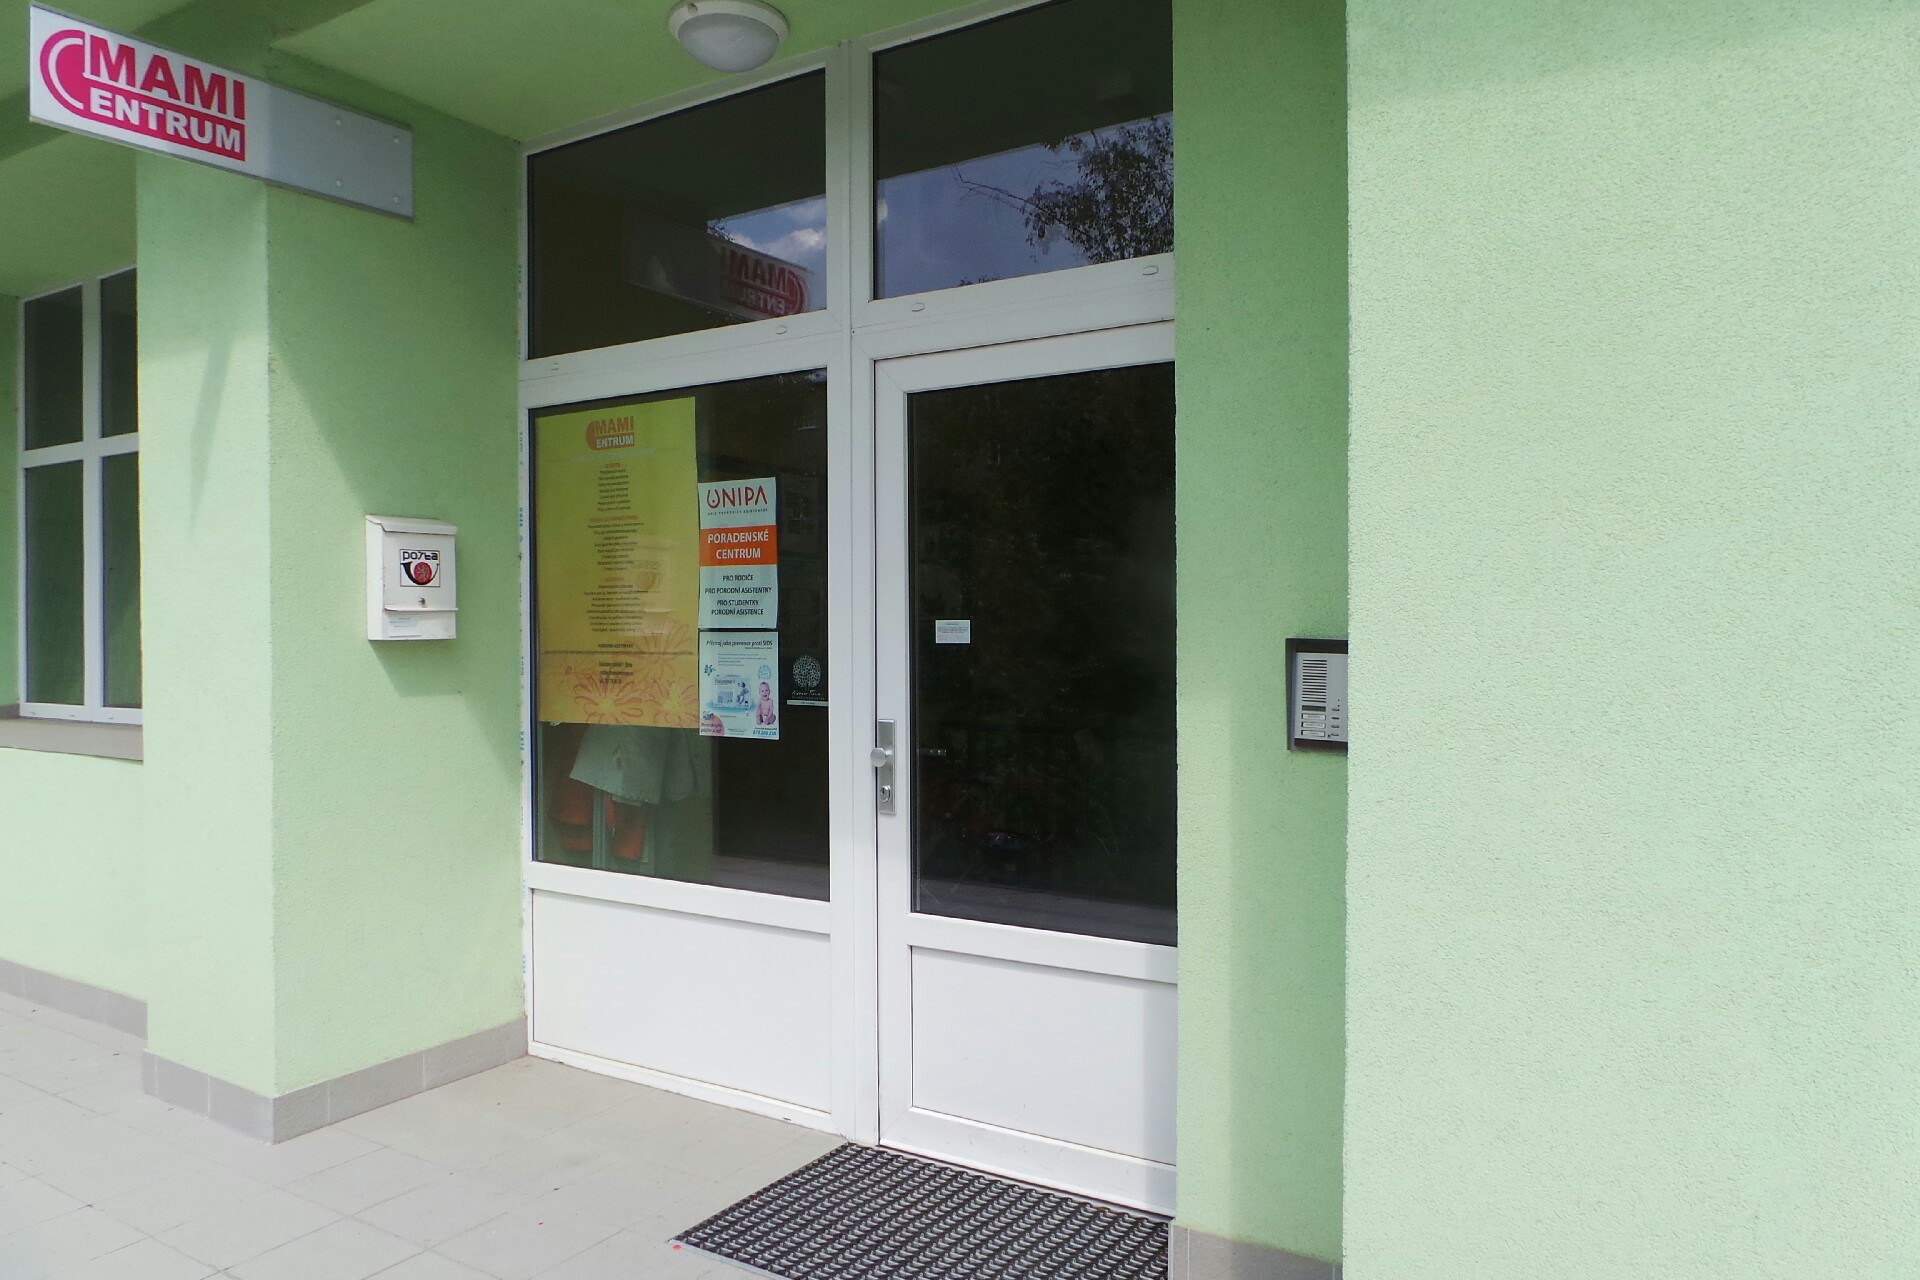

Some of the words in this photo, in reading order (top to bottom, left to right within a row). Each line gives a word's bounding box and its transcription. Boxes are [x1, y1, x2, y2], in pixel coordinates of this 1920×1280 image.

[90, 34, 245, 120] MAMI
[594, 416, 635, 435] MAMI
[707, 485, 768, 509] UNIPA
[707, 529, 769, 544] PORADENSKÉ
[717, 548, 761, 559] CENTRUM
[741, 586, 773, 594] ASISTENTKY
[736, 608, 764, 616] ASISTENCE
